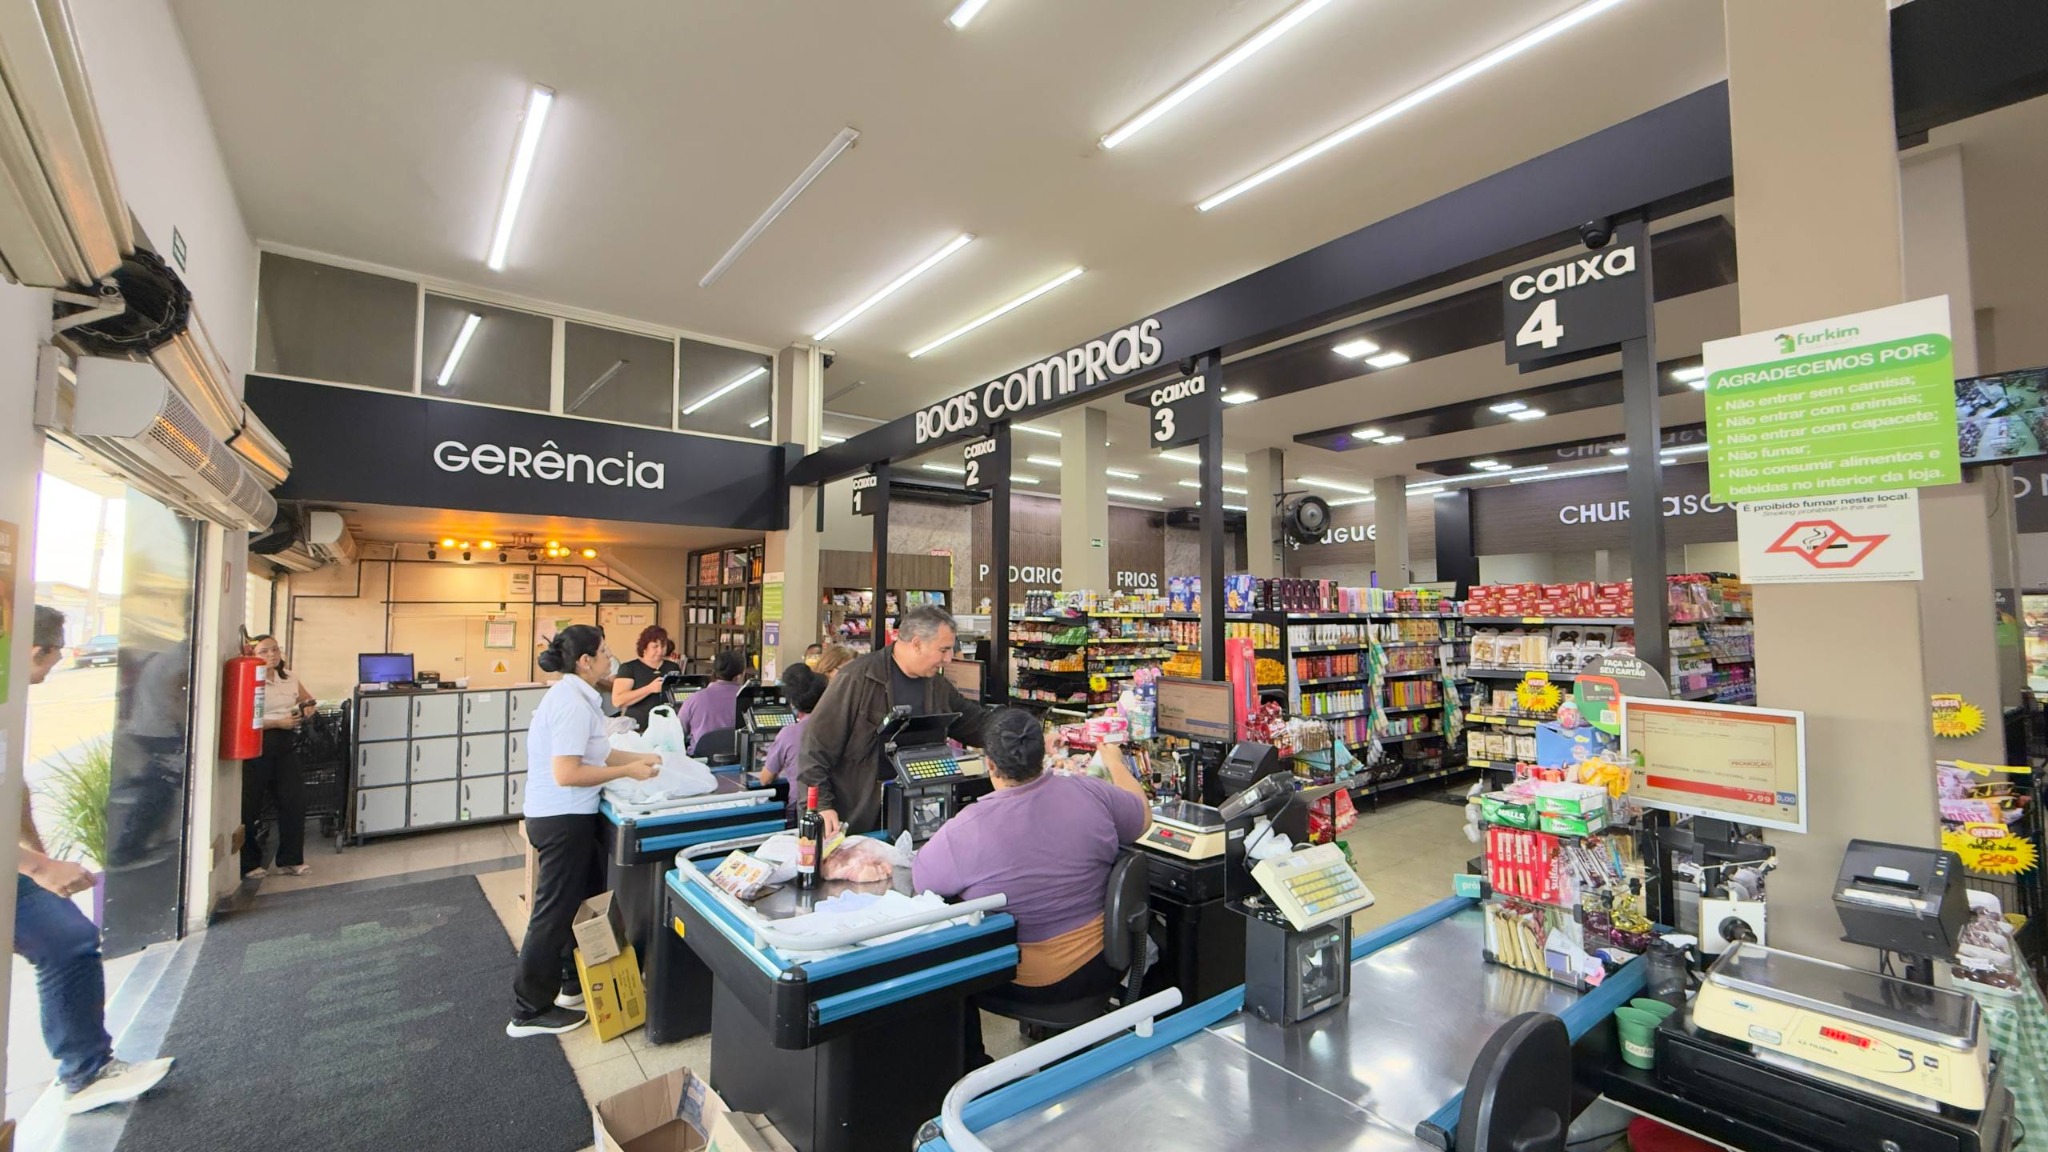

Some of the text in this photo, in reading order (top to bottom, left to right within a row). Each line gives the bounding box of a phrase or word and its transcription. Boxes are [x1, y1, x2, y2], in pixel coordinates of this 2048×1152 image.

[1510, 246, 1636, 300] caixa
[1516, 298, 1564, 348] 4
[1798, 326, 1859, 345] furkim
[1716, 343, 1936, 389] AGRADECEMOS POR:
[1151, 375, 1205, 407] caixa
[1725, 375, 1916, 411] Não entrar sem camisa;
[1726, 394, 1923, 428] Não entrar com animais;
[1154, 408, 1176, 442] 3
[1727, 410, 1939, 445] Não entrar com capacete;
[1728, 444, 1811, 462] Não fumar;
[1728, 450, 1940, 479] Não consumir alimentos e
[966, 460, 979, 486] 2
[1729, 468, 1945, 496] bebidas no interior da loja.
[853, 491, 862, 512] 1
[1754, 501, 1800, 512] proibido
[1802, 500, 1838, 508] fumar
[1840, 496, 1874, 505] neste
[1878, 492, 1911, 501] local.
[1116, 571, 1158, 588] FRIOS
[1600, 666, 1646, 676] SEU CARTÃO
[1604, 659, 1642, 668] FAÇA JÁ O
[1731, 760, 1772, 768] PROMOÇÃO
[1746, 794, 1772, 804] 7,99
[1971, 828, 2005, 838] OFERTA
